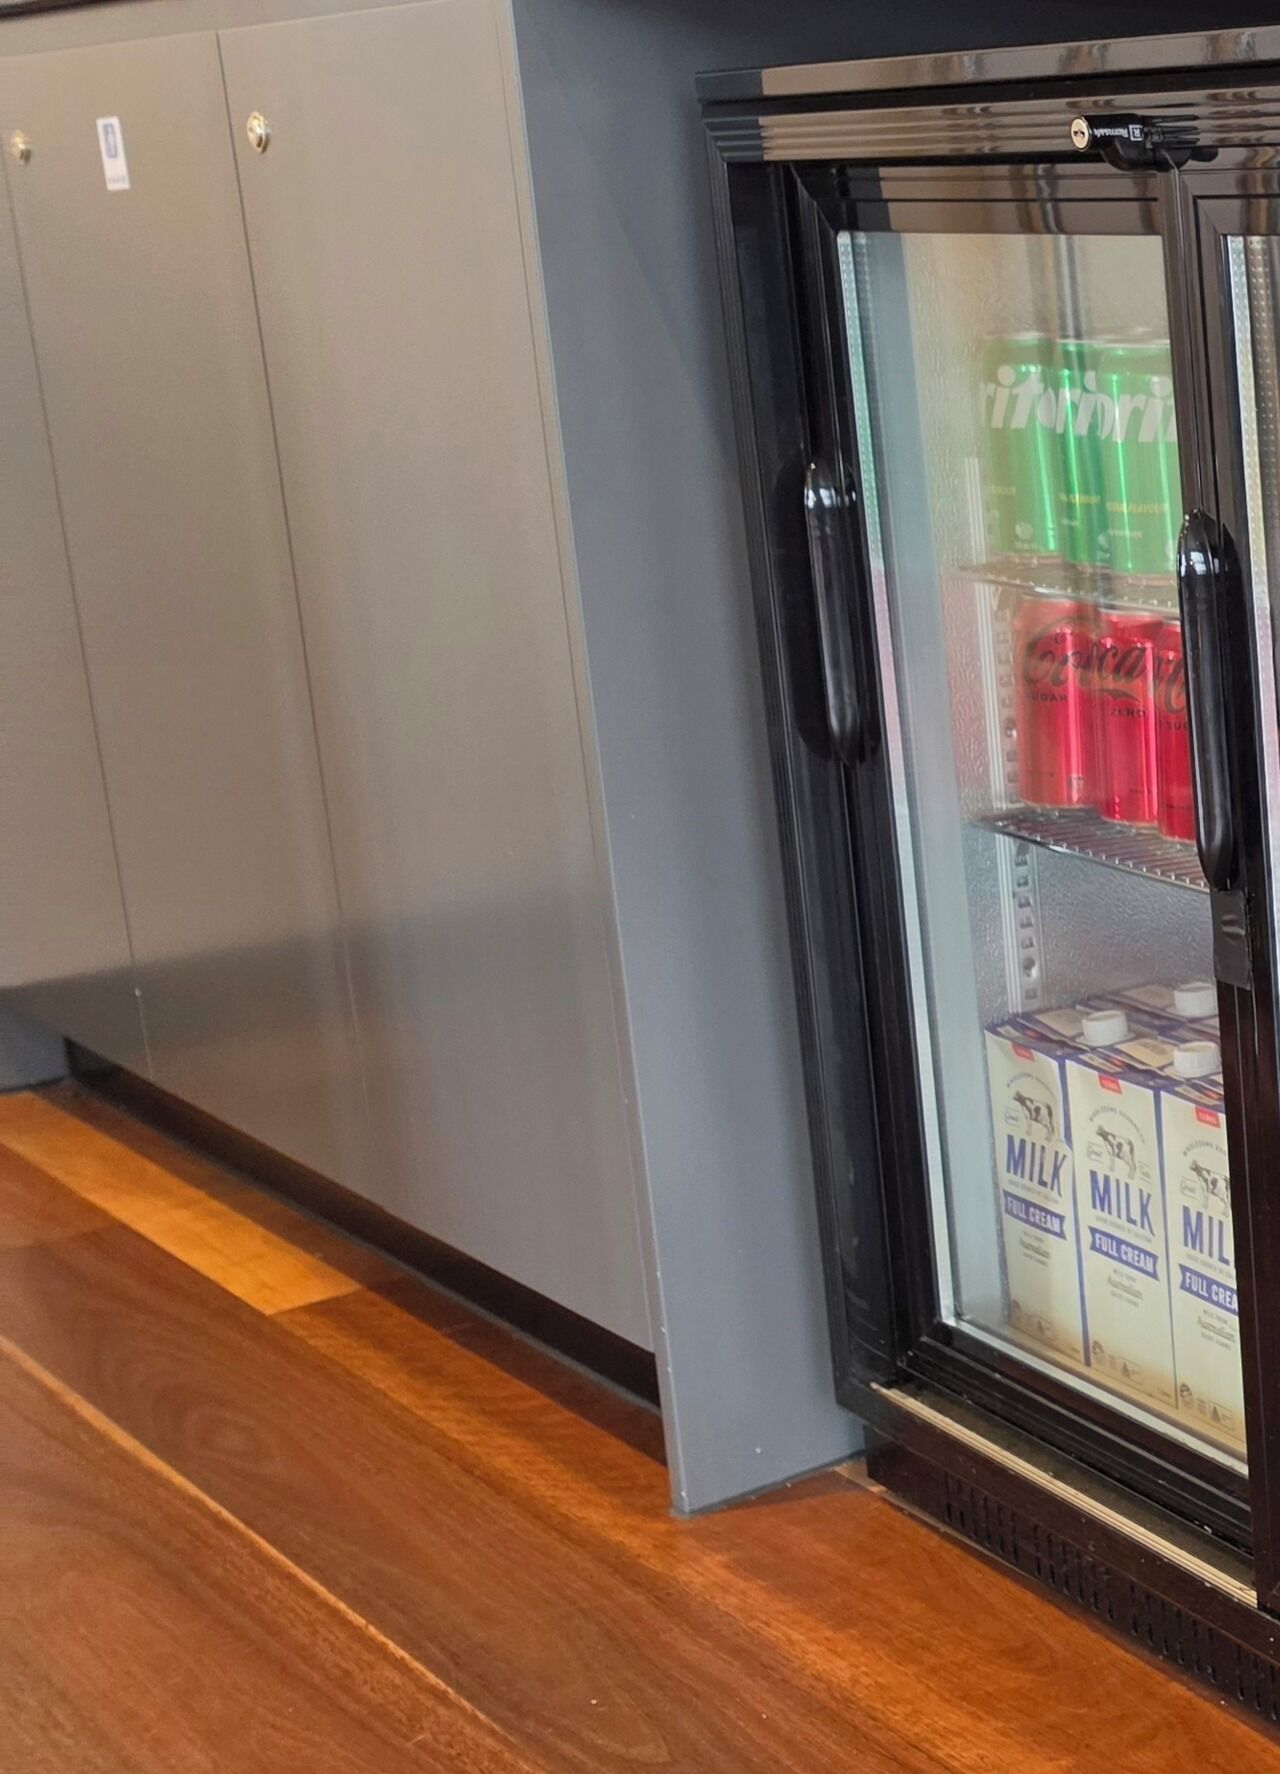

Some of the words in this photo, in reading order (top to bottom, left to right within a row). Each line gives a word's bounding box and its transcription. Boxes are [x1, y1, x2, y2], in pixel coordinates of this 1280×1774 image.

[1006, 1133, 1067, 1198] MILK
[1029, 1206, 1061, 1235] CREAM
[1089, 1169, 1155, 1237] MILK
[1095, 1232, 1119, 1258] FULL
[1120, 1244, 1154, 1273] CREAM
[1182, 1204, 1230, 1266] MIL
[1185, 1271, 1208, 1298] FULL
[1211, 1284, 1239, 1312] CREA
